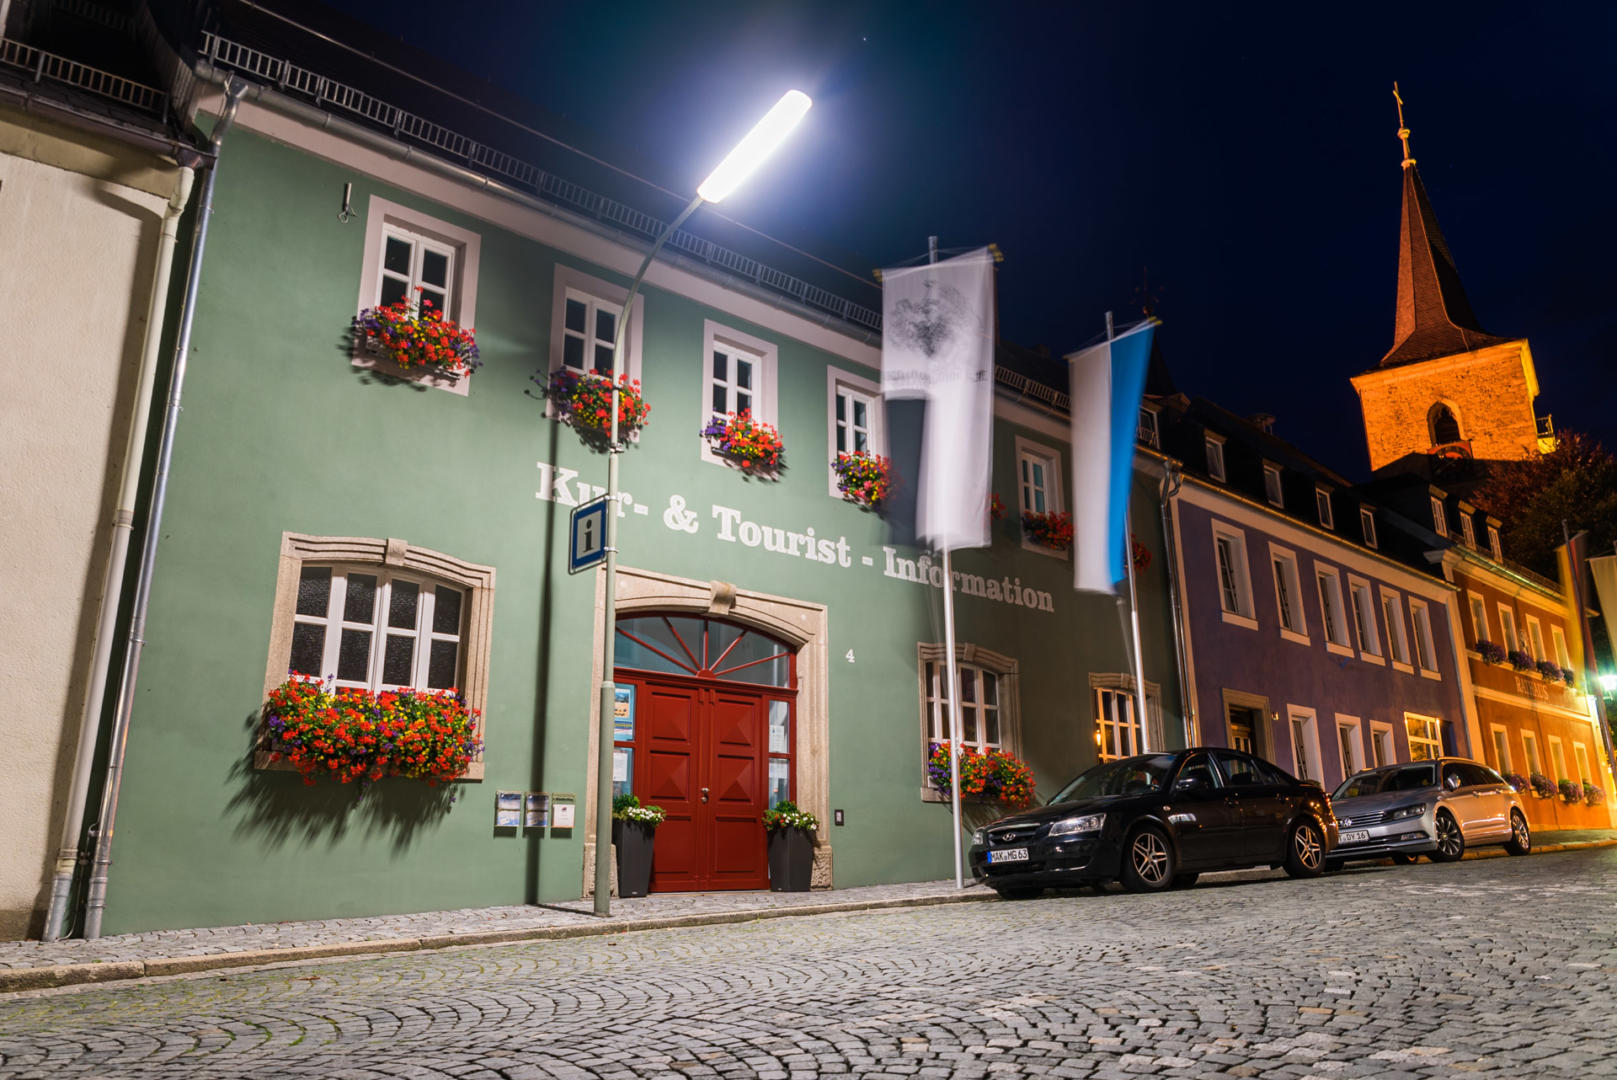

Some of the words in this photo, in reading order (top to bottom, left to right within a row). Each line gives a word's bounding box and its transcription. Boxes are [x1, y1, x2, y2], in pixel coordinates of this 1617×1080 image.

[663, 494, 699, 535] &
[711, 504, 852, 568] Tourist
[882, 546, 1055, 613] Information
[845, 648, 856, 663] 4
[1018, 848, 1028, 859] 63
